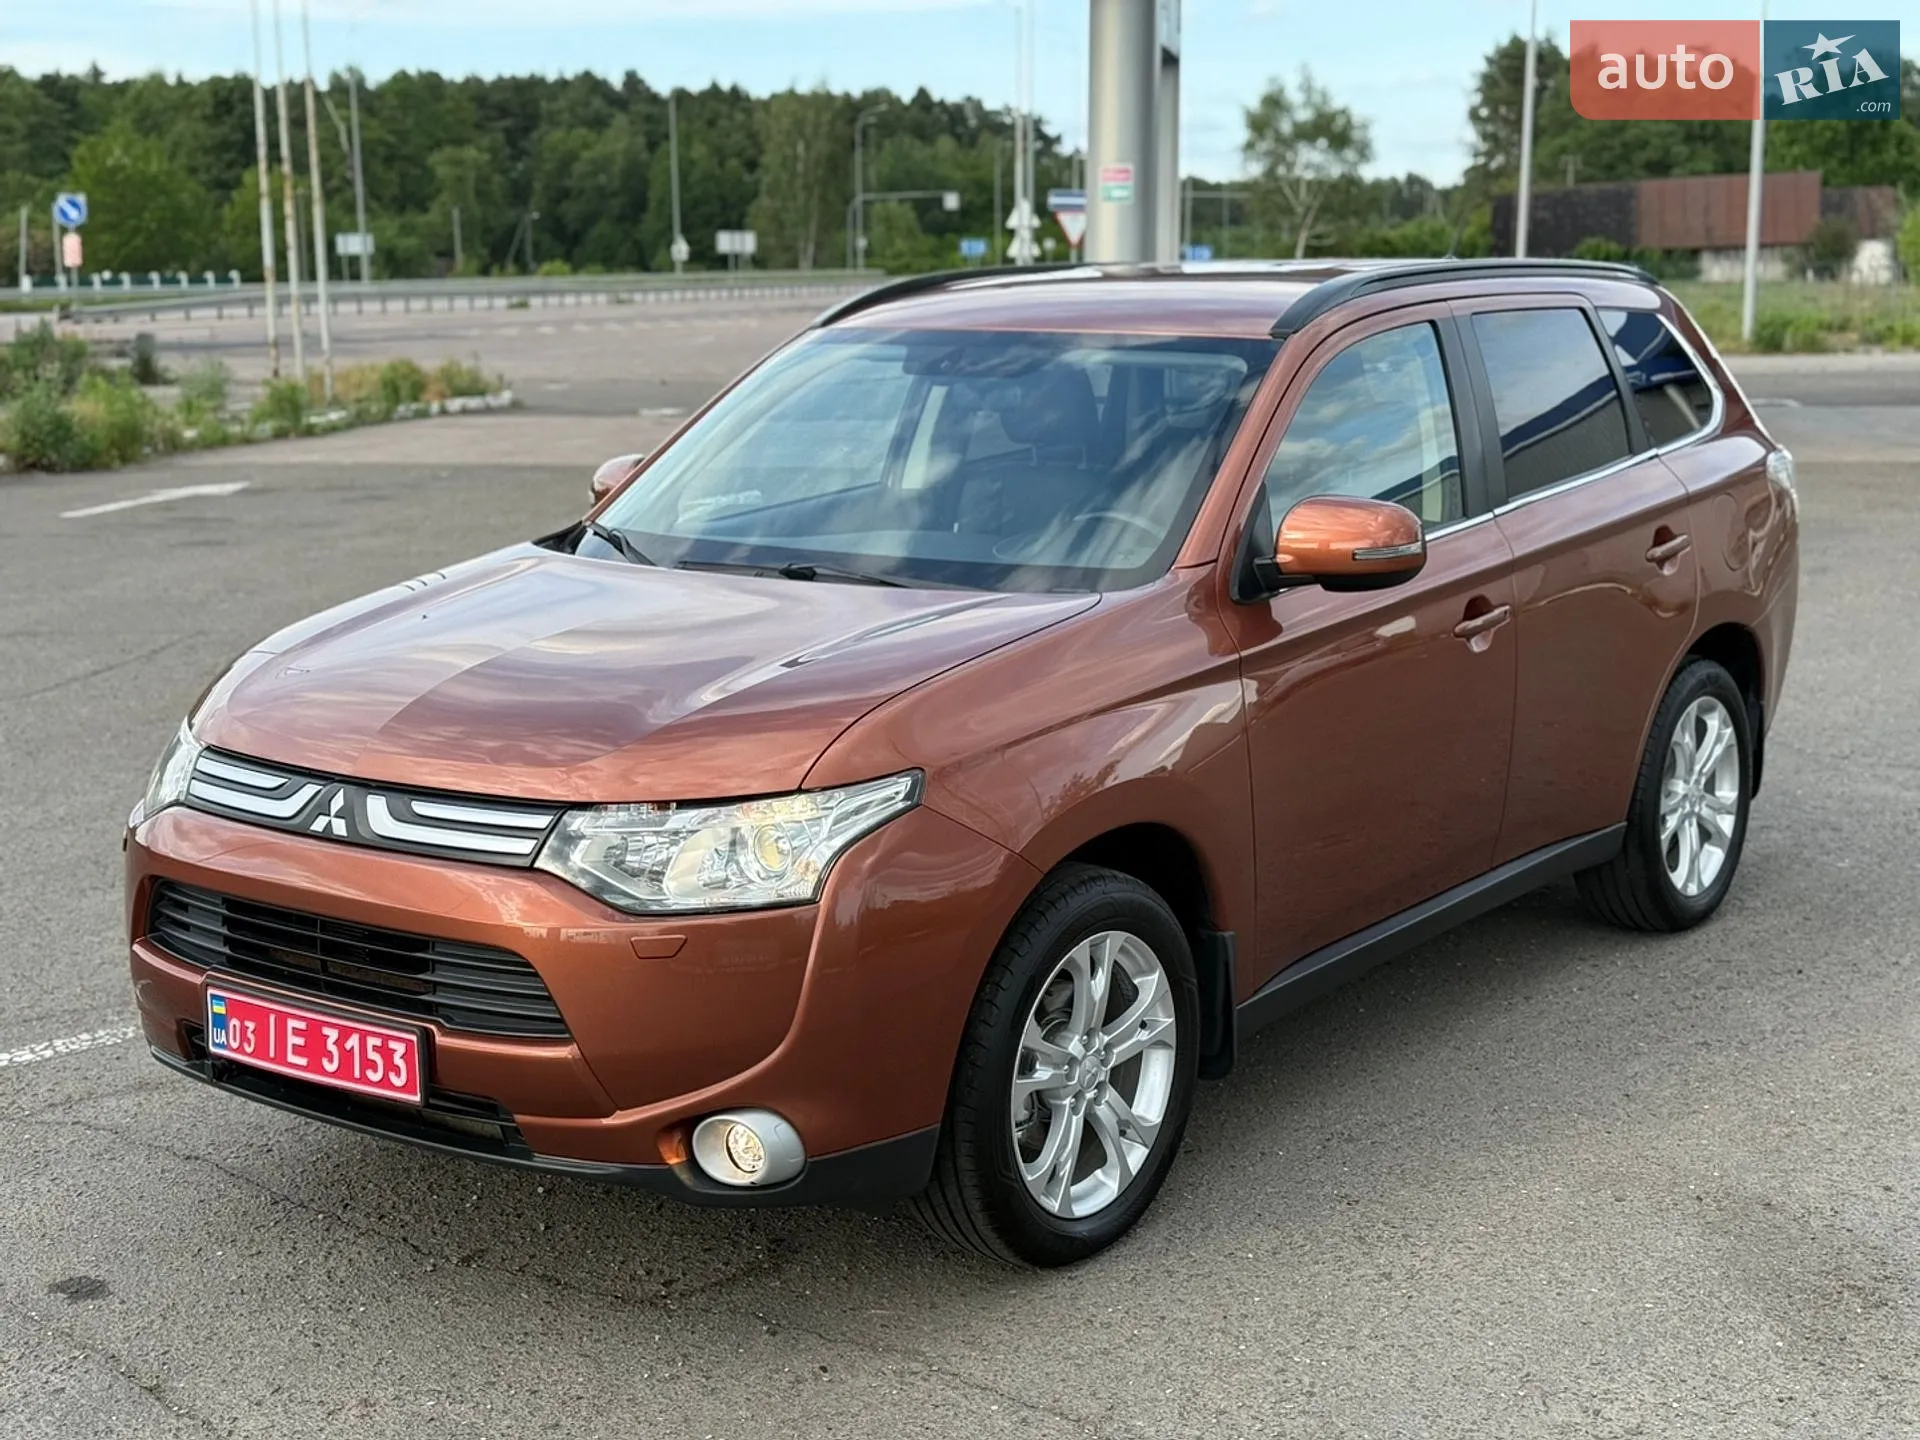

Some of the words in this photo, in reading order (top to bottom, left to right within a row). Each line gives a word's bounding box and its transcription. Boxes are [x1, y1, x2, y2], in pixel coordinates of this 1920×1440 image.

[213, 1028, 228, 1046] UA
[228, 1017, 257, 1054] 03
[321, 1026, 408, 1088] 3153
